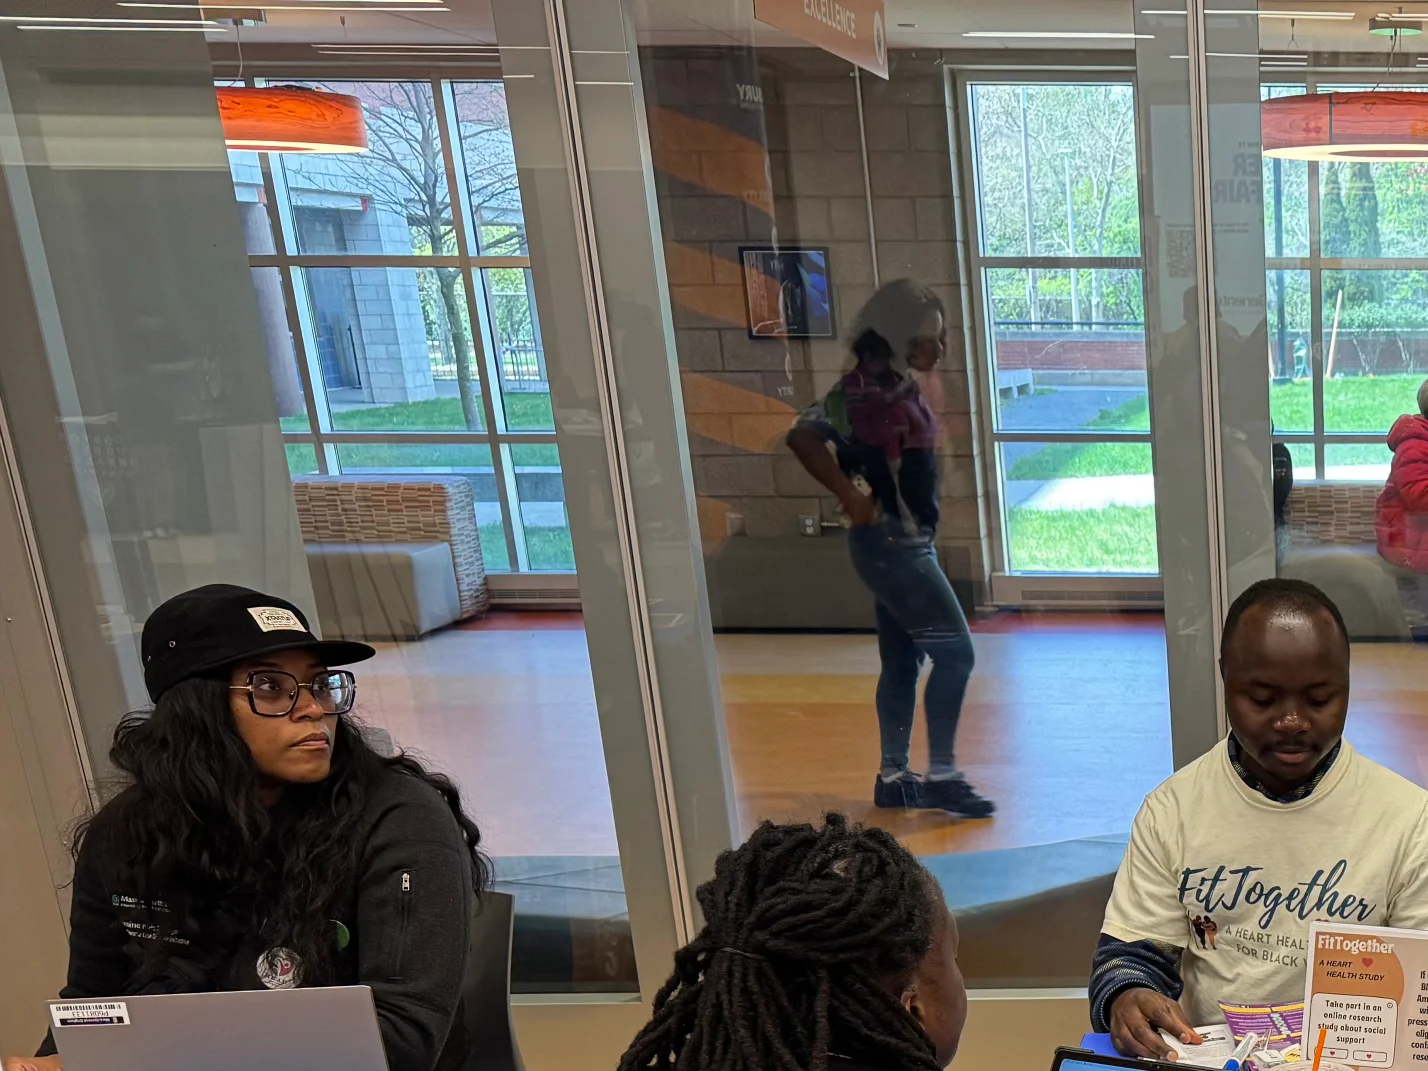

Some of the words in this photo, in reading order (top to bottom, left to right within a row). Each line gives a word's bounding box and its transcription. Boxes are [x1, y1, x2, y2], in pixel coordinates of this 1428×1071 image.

[804, 0, 857, 40] EXCELLENCE
[1178, 859, 1376, 929] FitTogether
[1225, 925, 1232, 935] A
[1235, 928, 1272, 945] HEART
[1317, 935, 1395, 954] FitTogether
[1236, 943, 1258, 958] FOR
[1261, 951, 1298, 967] BLACK
[1318, 959, 1325, 967] A
[1326, 960, 1353, 968] HEART
[1326, 970, 1358, 980] HEALTH
[1359, 973, 1385, 982] STUDY
[1420, 970, 1426, 979] If
[1325, 1000, 1344, 1009] Take
[1345, 1002, 1361, 1012] part
[1363, 1003, 1371, 1011] in
[1323, 1011, 1347, 1020] online
[1349, 1014, 1382, 1023] research
[1317, 1022, 1338, 1032] study
[1340, 1023, 1362, 1032] about
[1364, 1025, 1386, 1034] social
[1336, 1035, 1365, 1045] support
